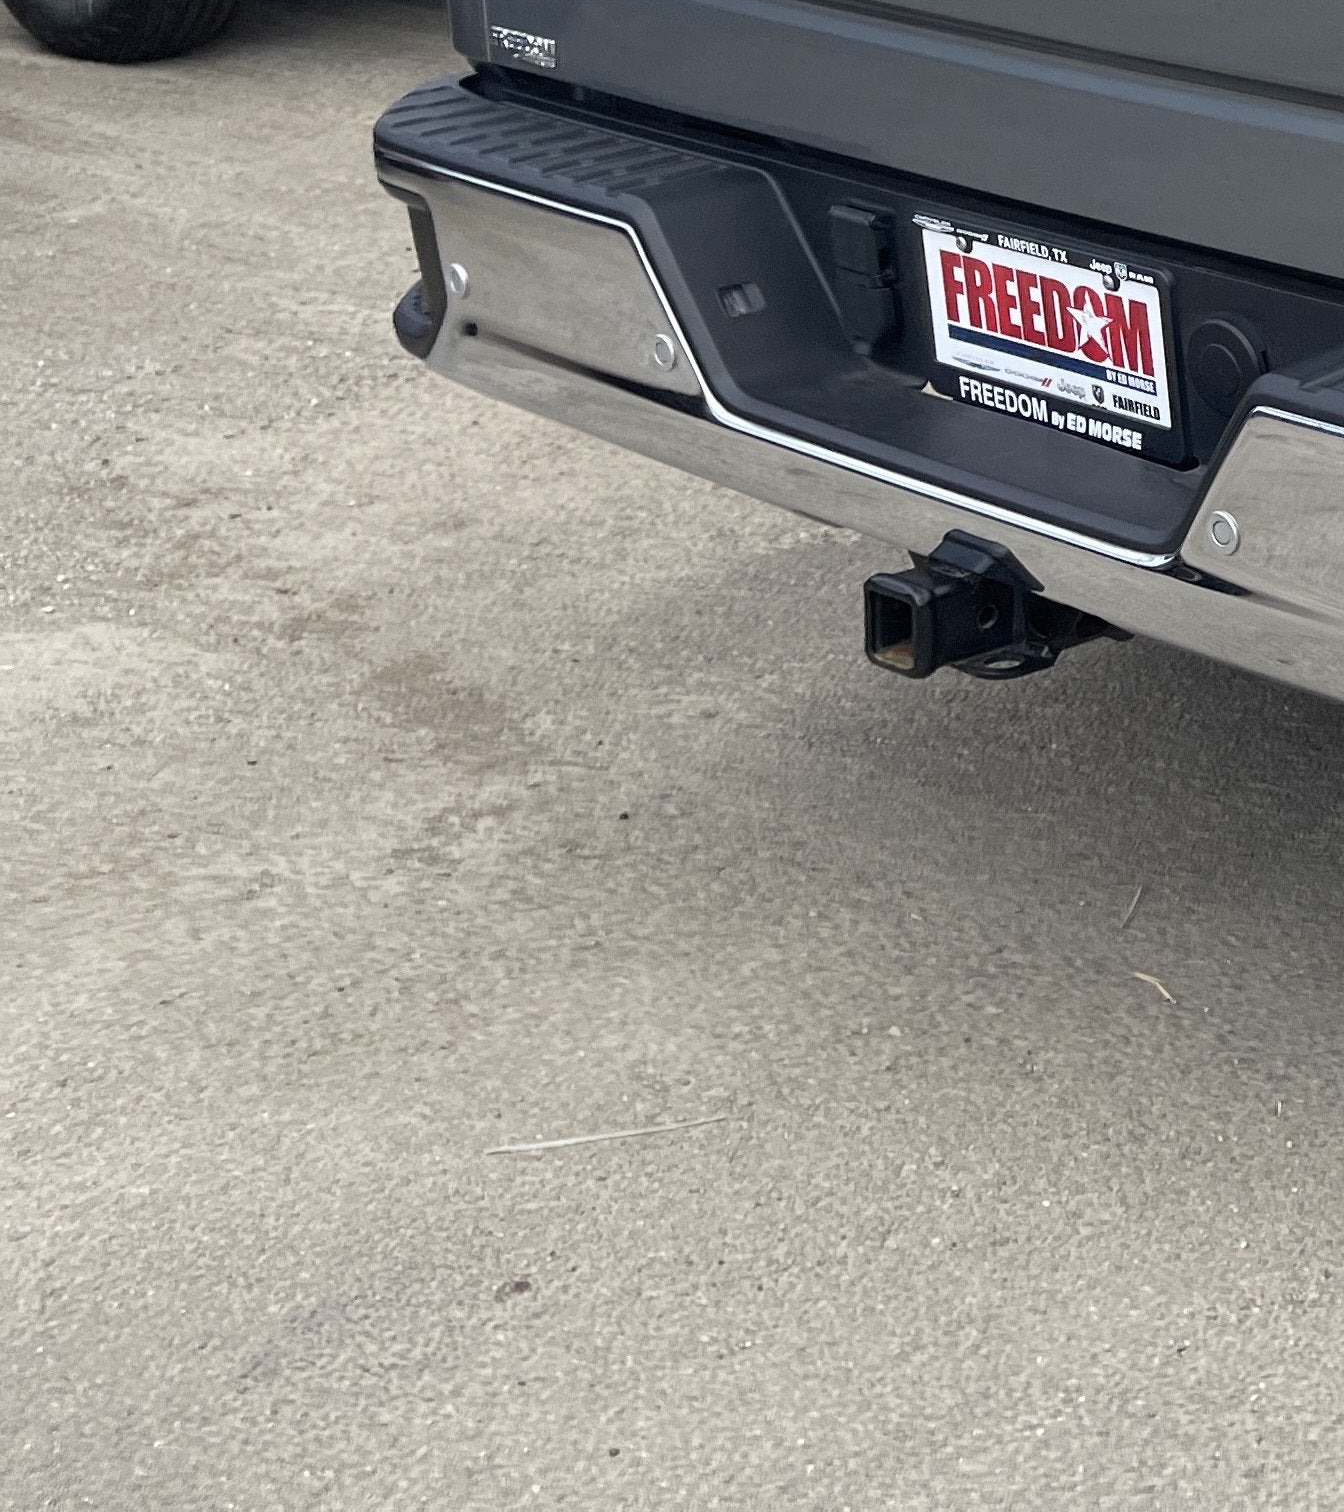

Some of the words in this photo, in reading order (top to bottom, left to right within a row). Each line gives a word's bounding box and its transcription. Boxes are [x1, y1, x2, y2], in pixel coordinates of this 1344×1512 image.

[1052, 248, 1068, 263] TX
[1089, 258, 1113, 275] Jeep
[1129, 271, 1154, 284] RAM
[939, 249, 1155, 376] FREEDOM
[1056, 377, 1086, 398] Jeep
[1106, 370, 1117, 382] BY
[1117, 371, 1128, 384] ED
[1127, 374, 1156, 393] MORSE
[958, 375, 1048, 423] FREEDOM
[1066, 412, 1086, 434] ED
[1088, 418, 1142, 450] MORSE
[1112, 394, 1160, 420] FAIRFIELD
